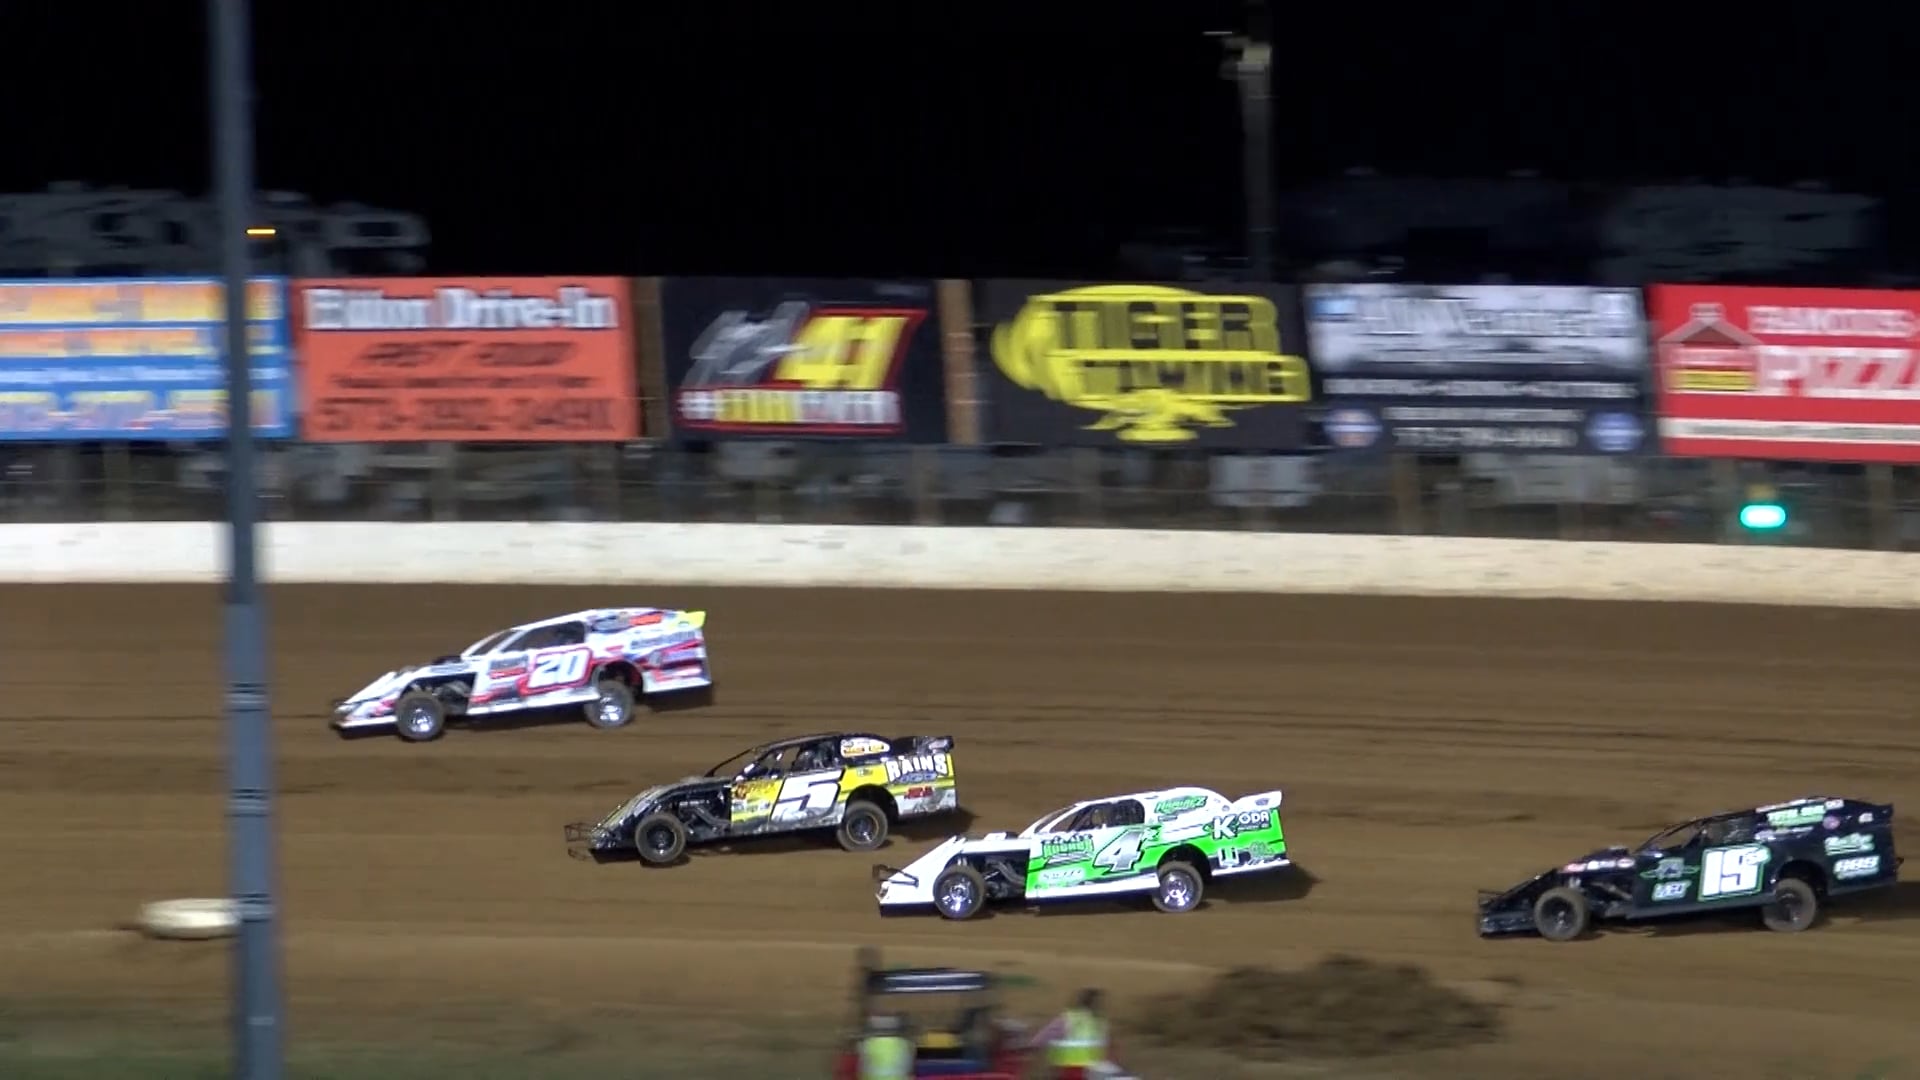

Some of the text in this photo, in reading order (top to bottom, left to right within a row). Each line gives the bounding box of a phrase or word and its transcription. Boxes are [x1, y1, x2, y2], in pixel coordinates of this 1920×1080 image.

[1053, 300, 1280, 351] TIGER
[1754, 345, 1920, 399] PIZZ
[528, 650, 591, 689] 20
[884, 753, 949, 783] RAINS
[771, 769, 843, 822] 5
[1702, 849, 1759, 897] 15
